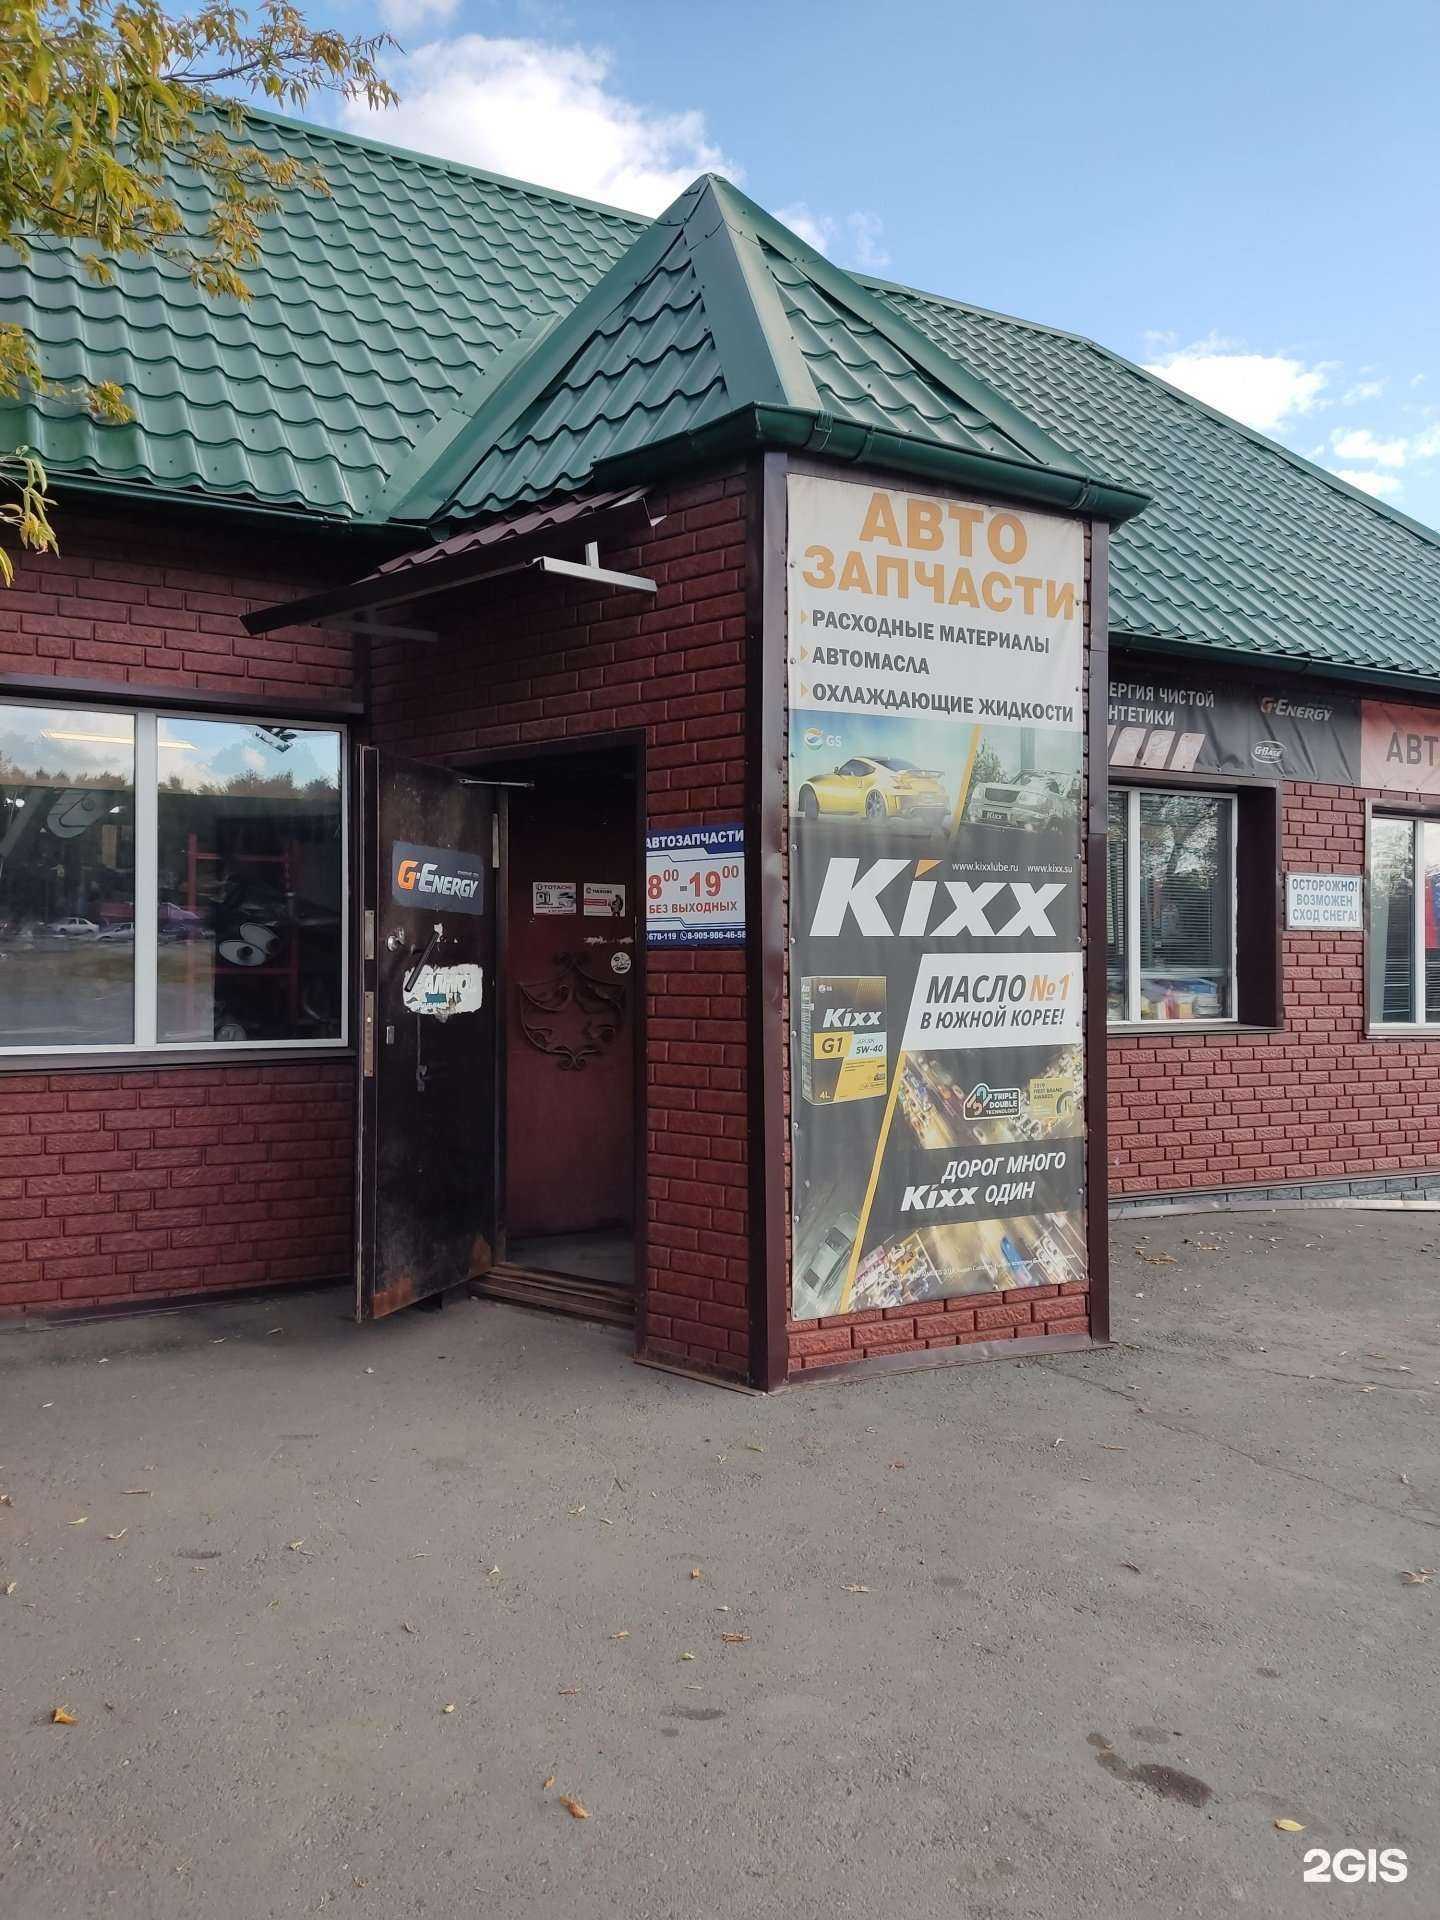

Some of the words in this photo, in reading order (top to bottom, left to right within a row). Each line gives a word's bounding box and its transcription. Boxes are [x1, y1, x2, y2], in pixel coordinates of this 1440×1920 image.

[859, 491, 1027, 565] АВТО
[802, 545, 1075, 621] ЗАПЧАСТИ
[812, 609, 935, 641] РАСХОДНЫЕ
[939, 625, 1050, 654] МАТЕРИАЛЫ
[812, 646, 931, 675] АВТОМАСЛА
[812, 683, 974, 715] ОХЛАЖДАЮЩИЕ
[978, 699, 1074, 723] ЖИДКОСТИ
[1159, 687, 1215, 708] ЧИСТОЙ
[826, 735, 842, 748] GS
[1386, 731, 1439, 767] АВТ
[646, 829, 744, 849] АВТОЗАПЧАСТИ
[952, 861, 1019, 872] www.kixxlube.ru
[1026, 863, 1073, 874] www.kixx.su
[1292, 878, 1358, 893] ОСТОРОЖНО!
[809, 857, 1068, 937] Kixx
[1296, 893, 1353, 907] ВОЗМОЖЕН
[649, 903, 668, 914] БЕЗ
[671, 901, 738, 915] ВЫХОДНЫХ
[1292, 908, 1321, 923] СХОД
[1323, 909, 1357, 922] СНЕГА!
[926, 974, 1027, 1004] МАСЛО
[1029, 974, 1071, 1002] №1
[822, 1007, 883, 1028] Kixx
[920, 1011, 932, 1030] В
[935, 1004, 1007, 1030] ЮЖНОЙ
[1010, 1008, 1065, 1027] КОРЕЕ!
[821, 1037, 844, 1054] G1
[855, 1044, 884, 1055] 5W-40
[989, 1099, 1018, 1109] DOUBLE
[994, 1091, 1018, 1101] TRIPLE
[941, 1156, 1004, 1184] ДОРОГ
[1006, 1151, 1067, 1174] МНОГО
[900, 1182, 980, 1212] Kixx
[984, 1181, 1036, 1206] ОДИН
